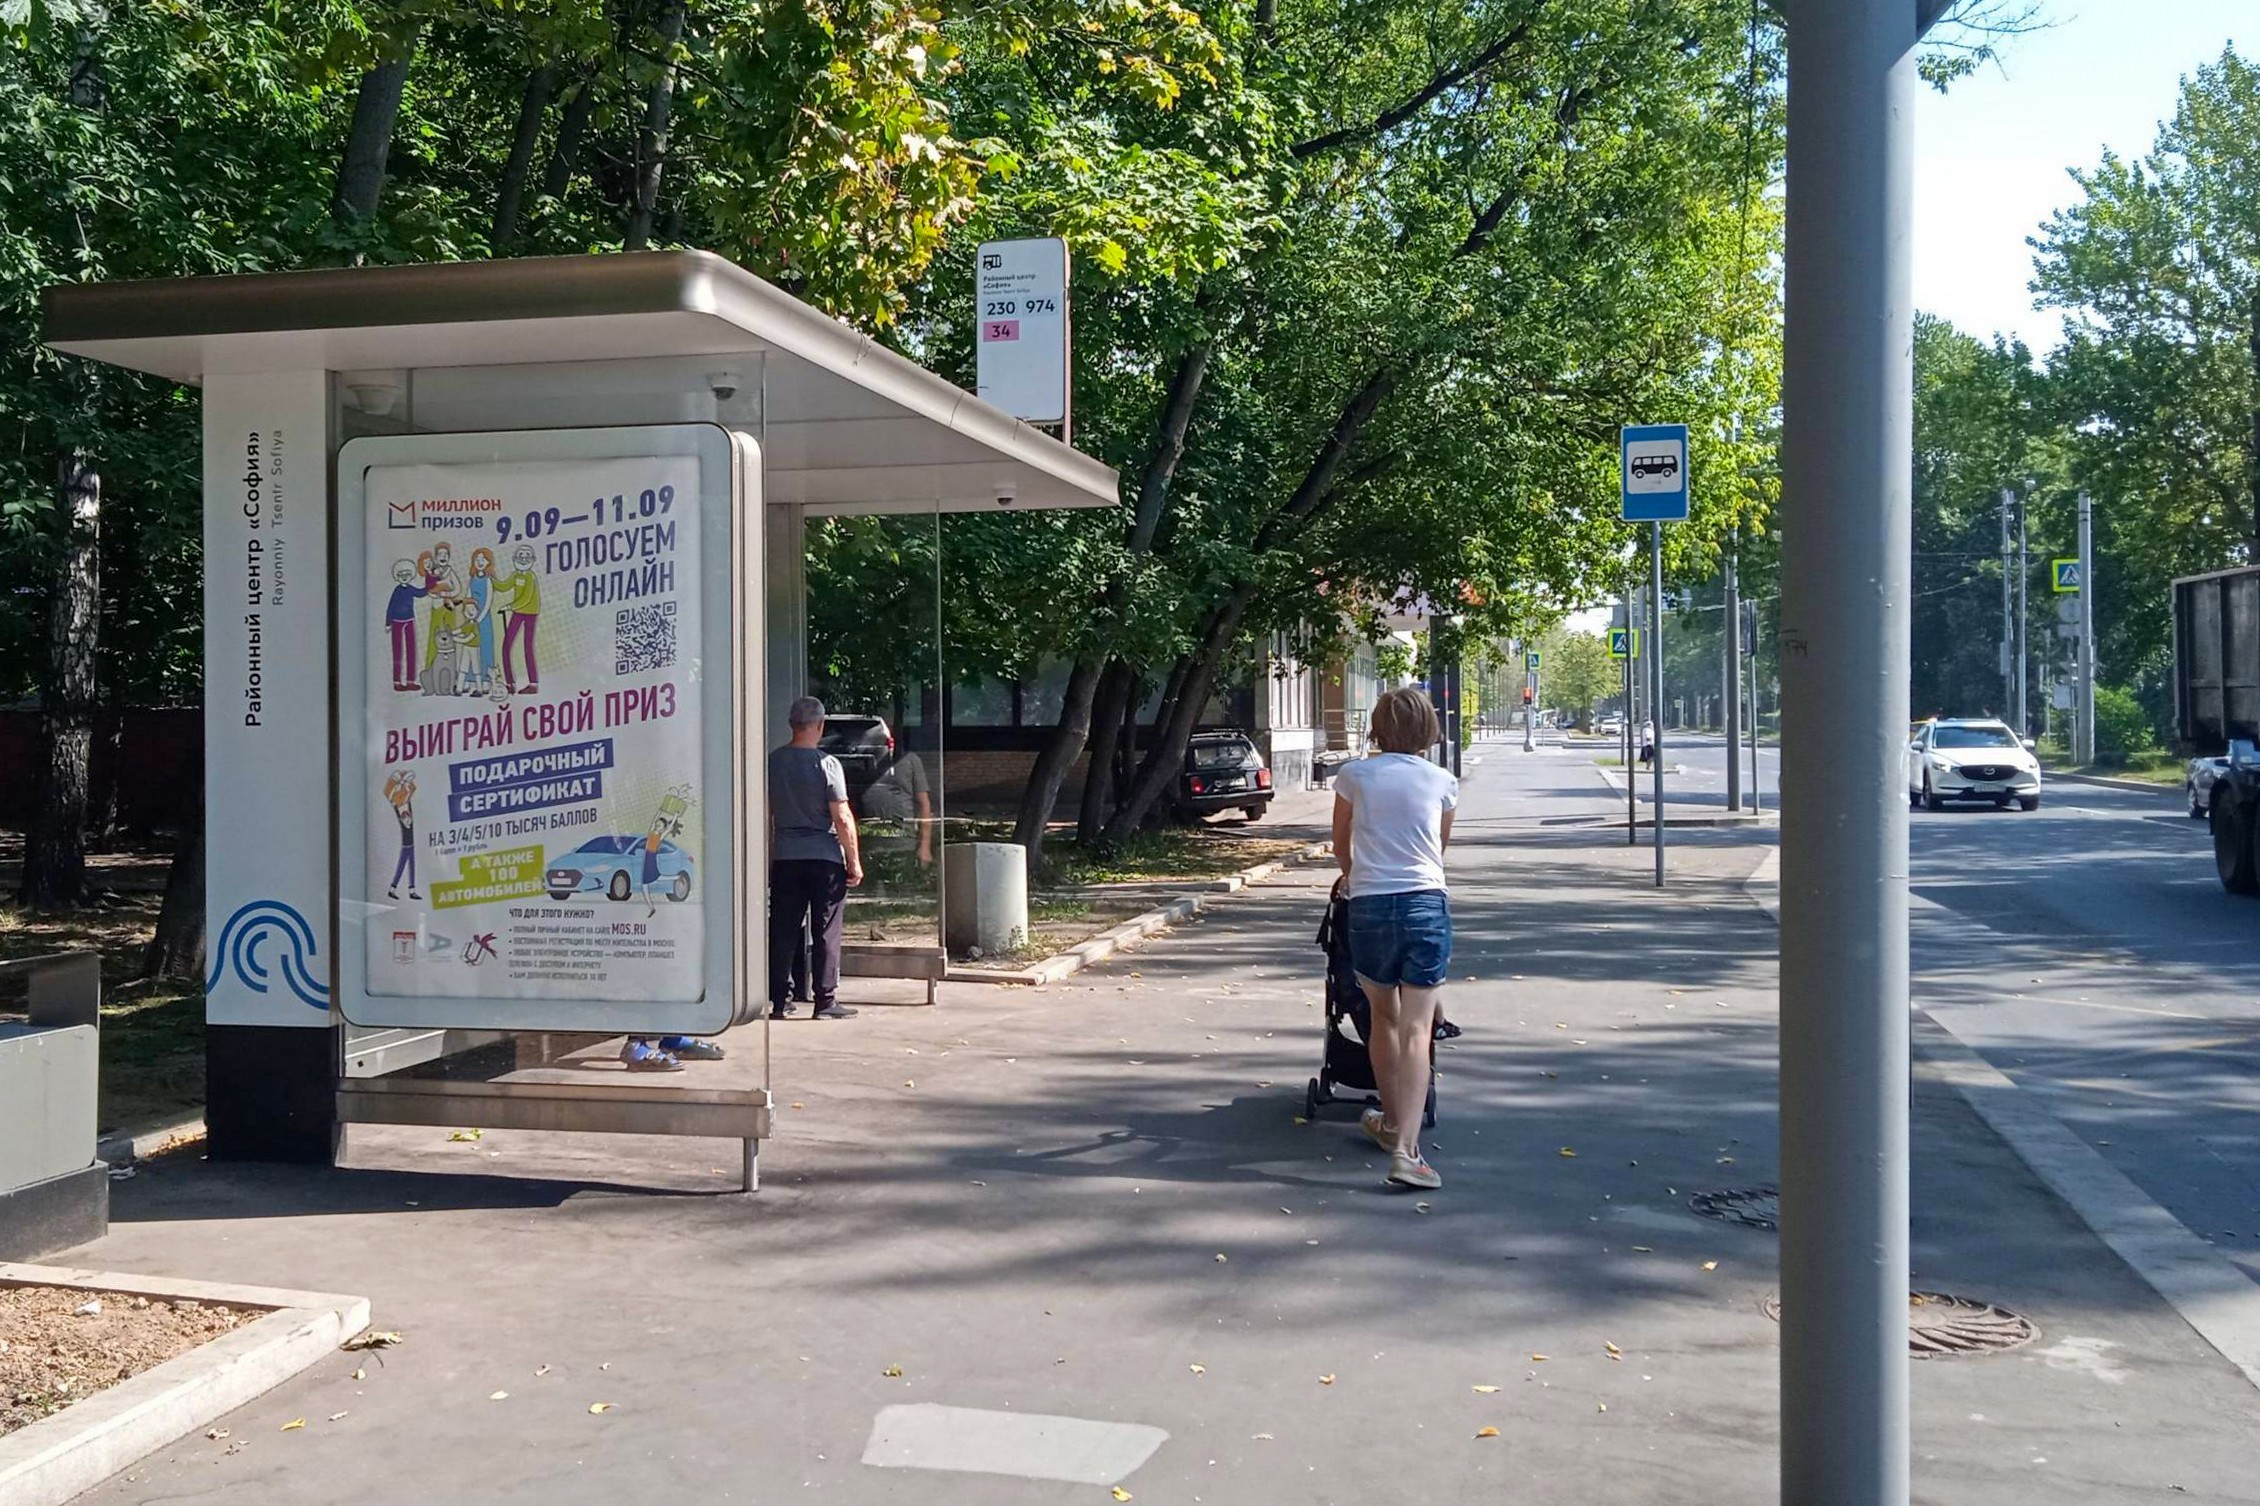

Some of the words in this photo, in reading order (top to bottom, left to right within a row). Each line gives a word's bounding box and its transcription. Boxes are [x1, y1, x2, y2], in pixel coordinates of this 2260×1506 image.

[987, 301, 1015, 315] 230
[1025, 299, 1055, 313] 974
[991, 325, 1010, 338] 34
[270, 430, 284, 476] Sofiya
[243, 431, 263, 530] «София»
[271, 484, 283, 528] Tsentr
[546, 520, 676, 574] ГОЛОСУЕМ
[248, 540, 263, 605] центр
[272, 538, 285, 606] Rayonniy
[574, 558, 675, 608] ОНЛАЙН
[245, 616, 261, 726] Районный
[385, 703, 512, 764] ВЫИГРАЙ
[523, 690, 594, 741] СВОЙ
[605, 682, 676, 728] ПРИЗ
[459, 743, 605, 785] ПОДАРОЧНЫЙ
[460, 777, 596, 813] СЕРТИФИКАТ
[429, 832, 445, 847] НА
[448, 822, 502, 844] 3/4/5/10
[505, 815, 546, 836] ТЫСЯЧ
[551, 807, 597, 829] БАЛЛОВ
[471, 857, 481, 868] А
[486, 850, 534, 867] ТАКЖЕ
[489, 866, 519, 882] 100
[438, 877, 542, 903] АВТОМОБИЛЕЙ
[509, 908, 522, 918] ЧТО
[524, 908, 540, 919] ДЛЯ
[541, 908, 562, 918] ЭТОГО
[564, 909, 595, 919] НУЖНО?
[612, 923, 646, 935] MOS.RU
